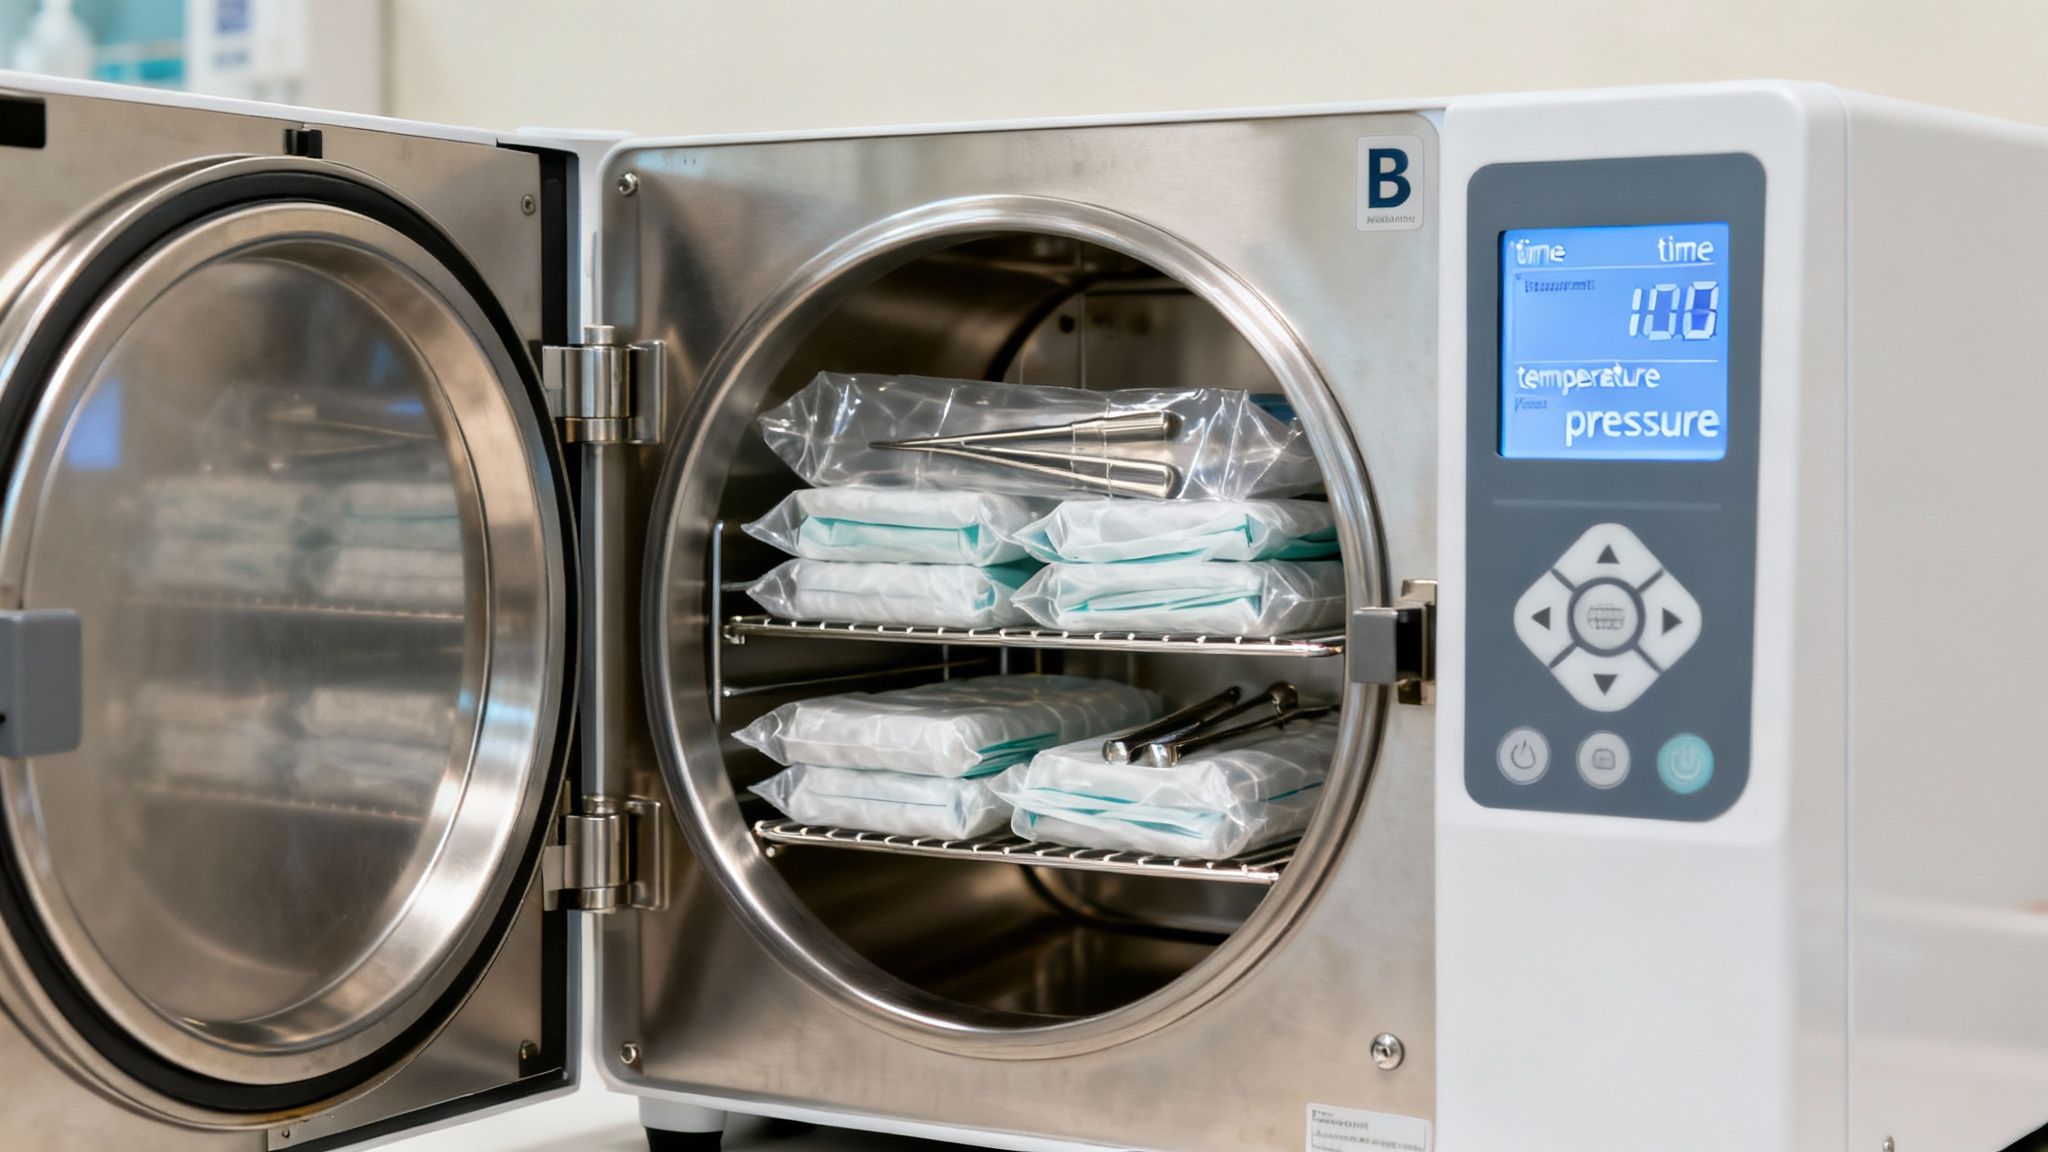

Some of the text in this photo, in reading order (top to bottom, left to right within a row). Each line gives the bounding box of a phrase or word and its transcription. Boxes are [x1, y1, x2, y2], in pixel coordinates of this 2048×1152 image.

[1368, 147, 1411, 208] B
[1658, 236, 1714, 262] time
[1565, 408, 1720, 447] pressure
